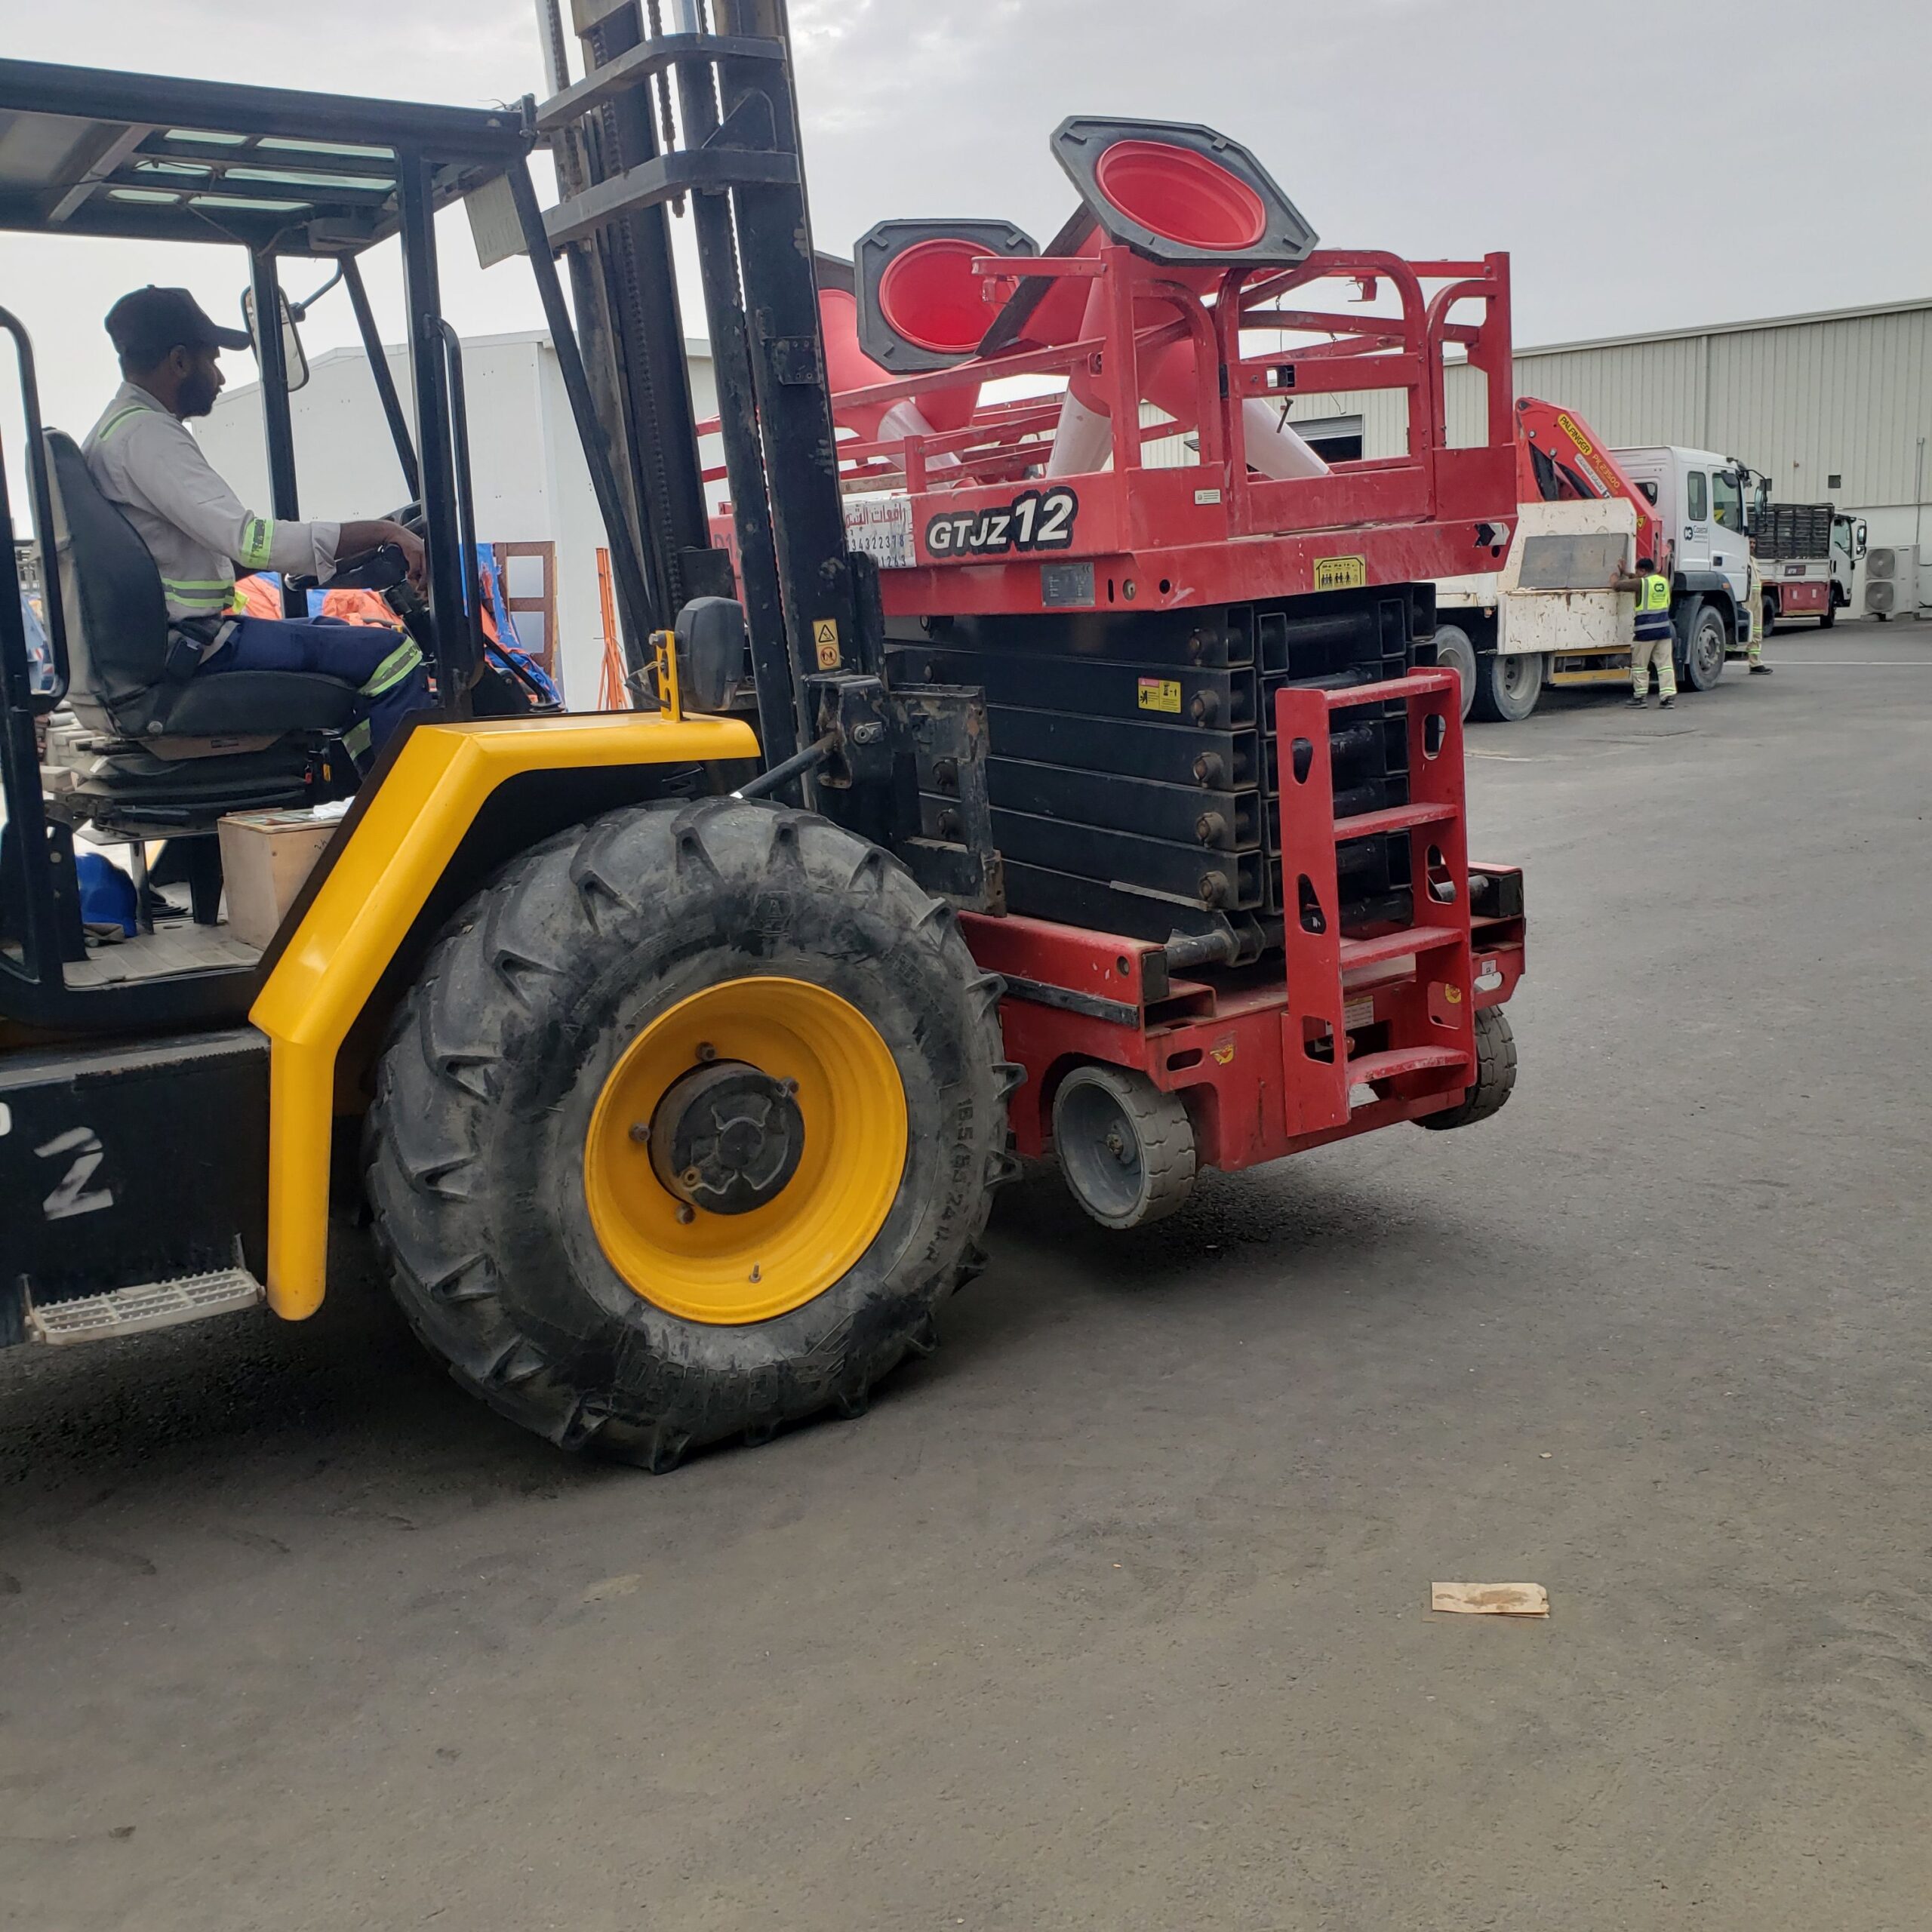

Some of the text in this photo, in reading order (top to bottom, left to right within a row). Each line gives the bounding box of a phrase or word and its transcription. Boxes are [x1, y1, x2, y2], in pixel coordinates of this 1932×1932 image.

[1560, 416, 1590, 454] PALFINGER
[1592, 454, 1601, 466] PK
[1599, 463, 1620, 489] 23500
[876, 555, 906, 568] 1263
[33, 1126, 114, 1221] 2
